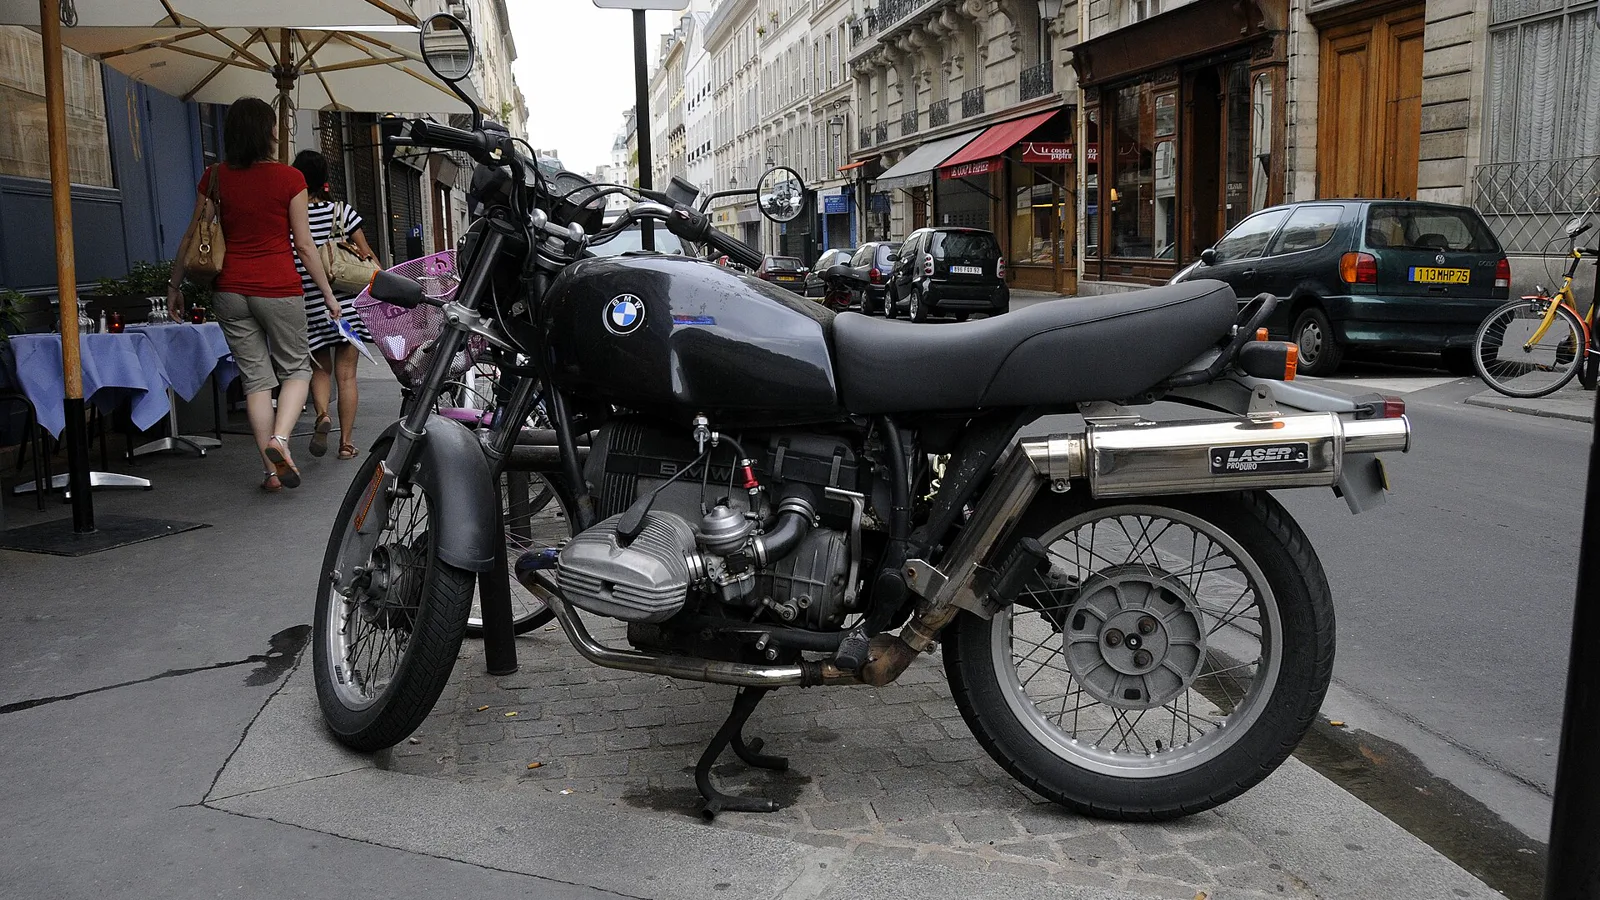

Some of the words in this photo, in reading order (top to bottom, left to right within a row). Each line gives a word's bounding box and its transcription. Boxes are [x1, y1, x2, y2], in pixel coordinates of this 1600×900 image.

[1456, 271, 1468, 281] 75
[612, 295, 643, 309] BMW
[1227, 447, 1292, 462] LASER
[660, 462, 732, 481] BMW
